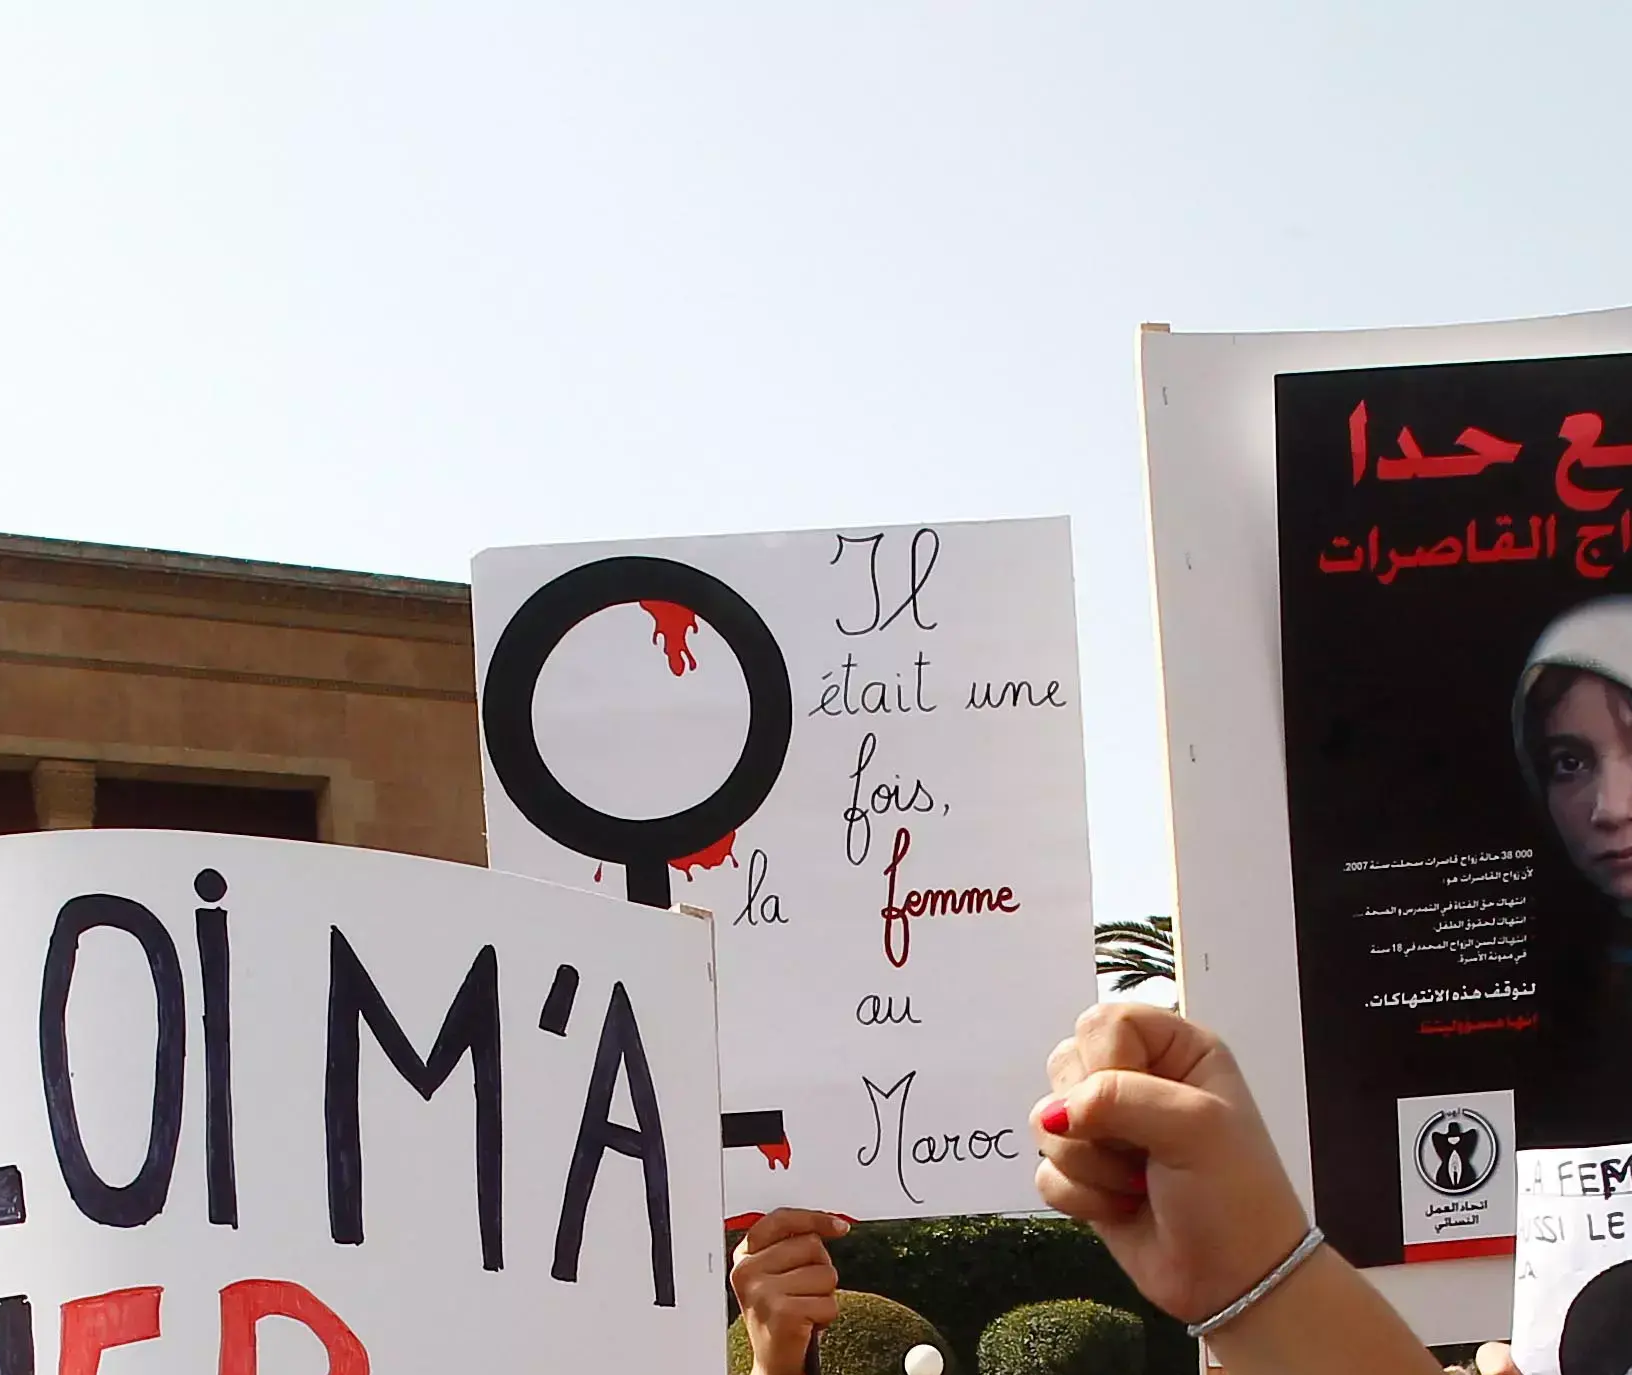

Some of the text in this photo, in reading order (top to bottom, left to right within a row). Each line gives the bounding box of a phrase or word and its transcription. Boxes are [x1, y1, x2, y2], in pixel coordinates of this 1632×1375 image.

[1350, 400, 1524, 487] حدا
[830, 527, 940, 636] Il
[1318, 512, 1558, 584] القاصرات
[808, 651, 1069, 718] était une
[844, 732, 950, 866] fois,
[733, 828, 1021, 968] la femme
[855, 990, 922, 1026] au
[1452, 985, 1482, 1001] هذه
[1484, 980, 1536, 1001] لنوقف
[326, 923, 678, 1307] M'A
[1586, 1210, 1626, 1241] LE
